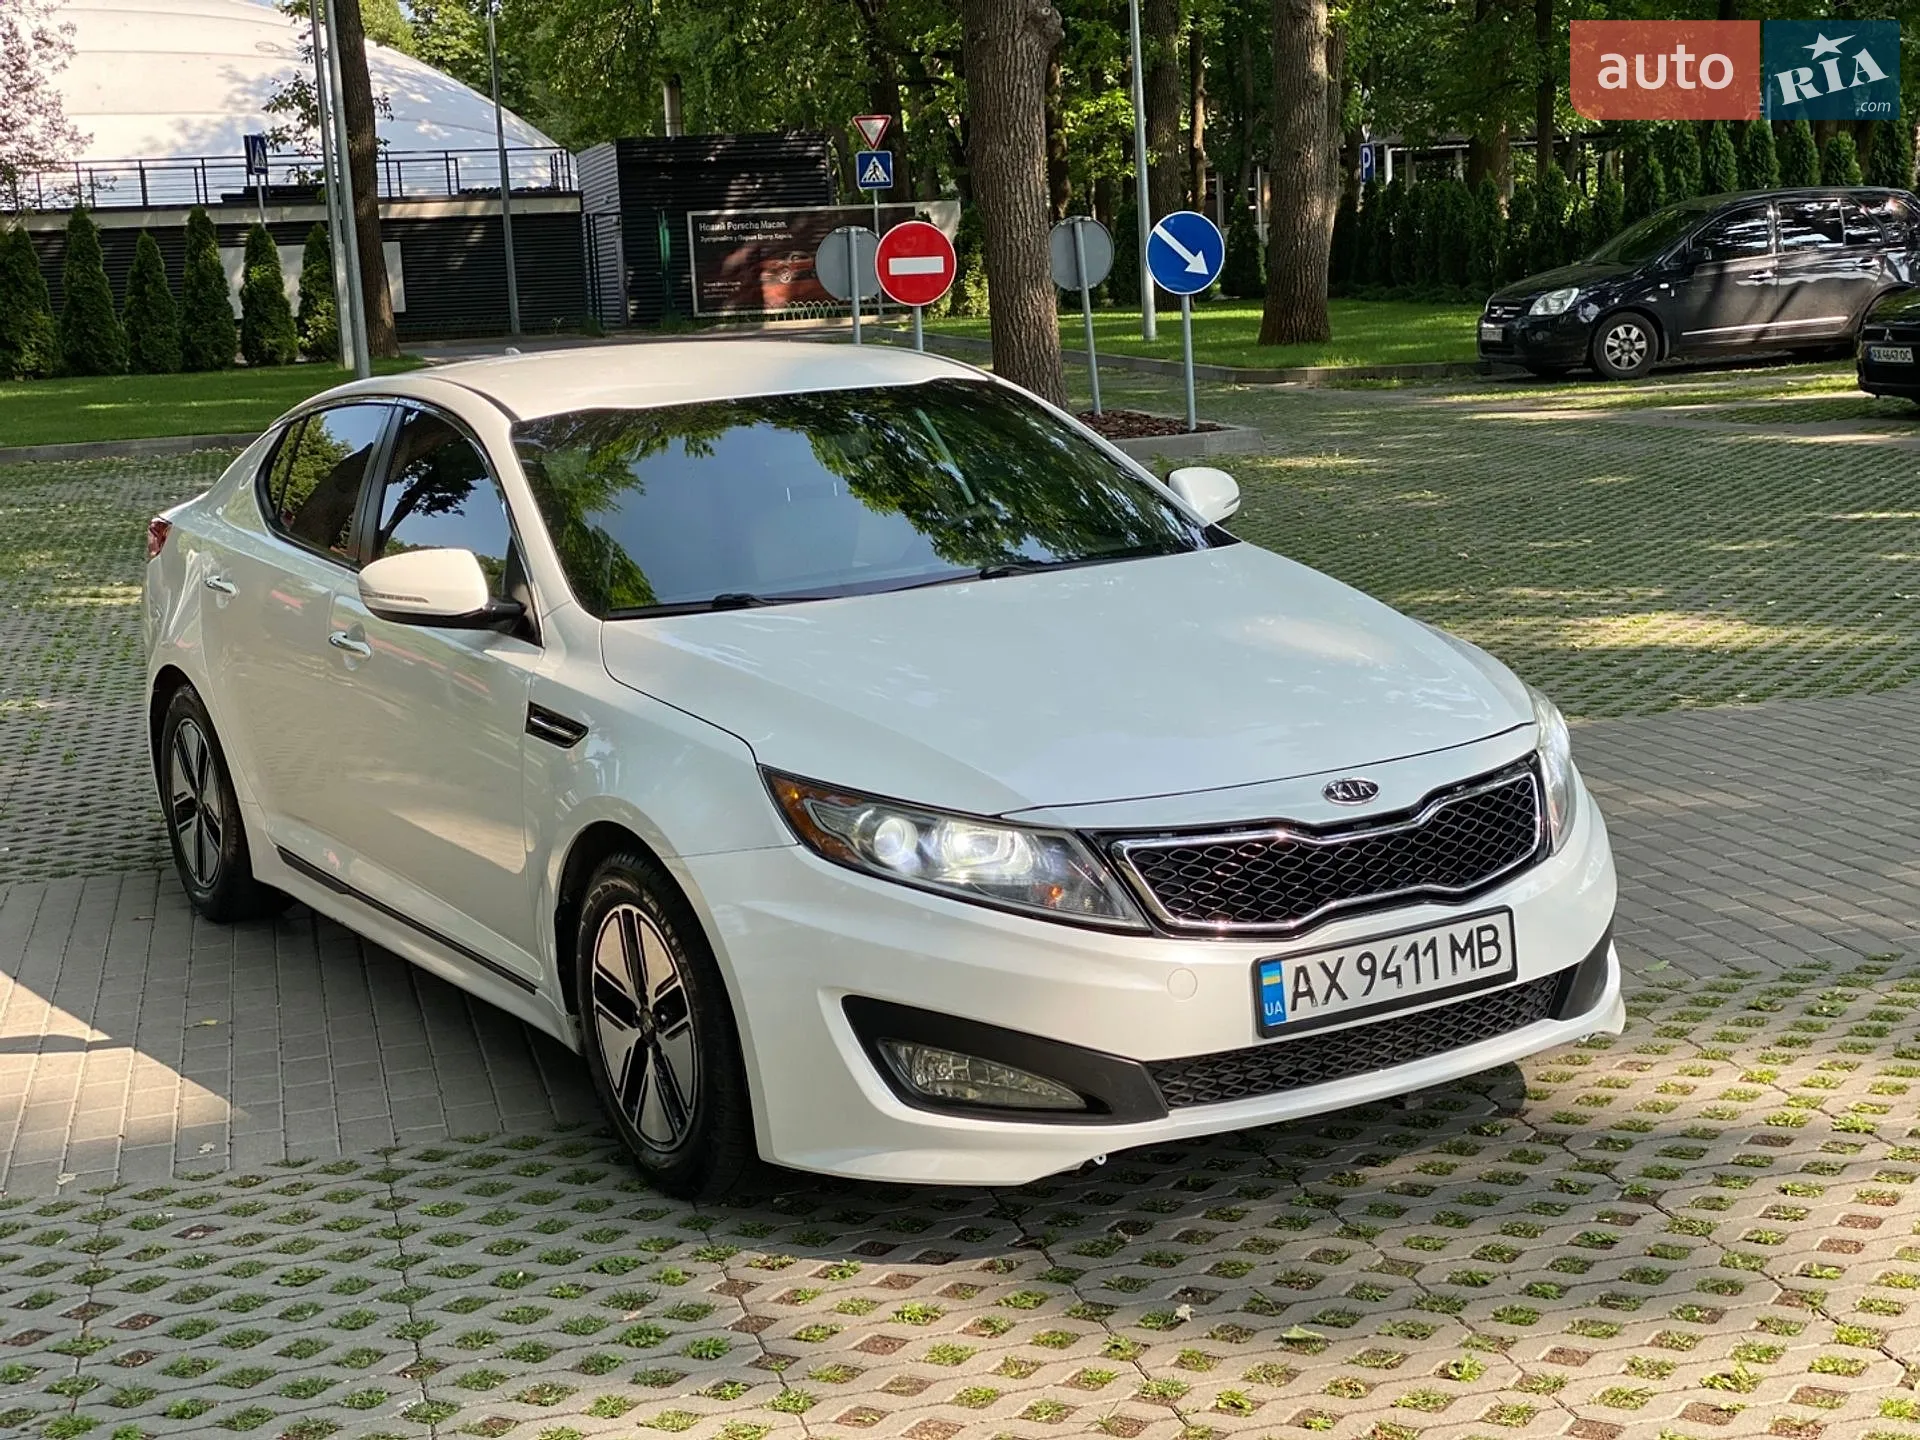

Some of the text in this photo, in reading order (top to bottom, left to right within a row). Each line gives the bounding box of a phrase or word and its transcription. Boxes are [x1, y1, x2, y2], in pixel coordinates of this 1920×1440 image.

[1362, 146, 1371, 180] P
[1331, 781, 1374, 799] KIA
[1290, 923, 1502, 1012] AX 9411 MB
[1265, 1003, 1283, 1016] UA
